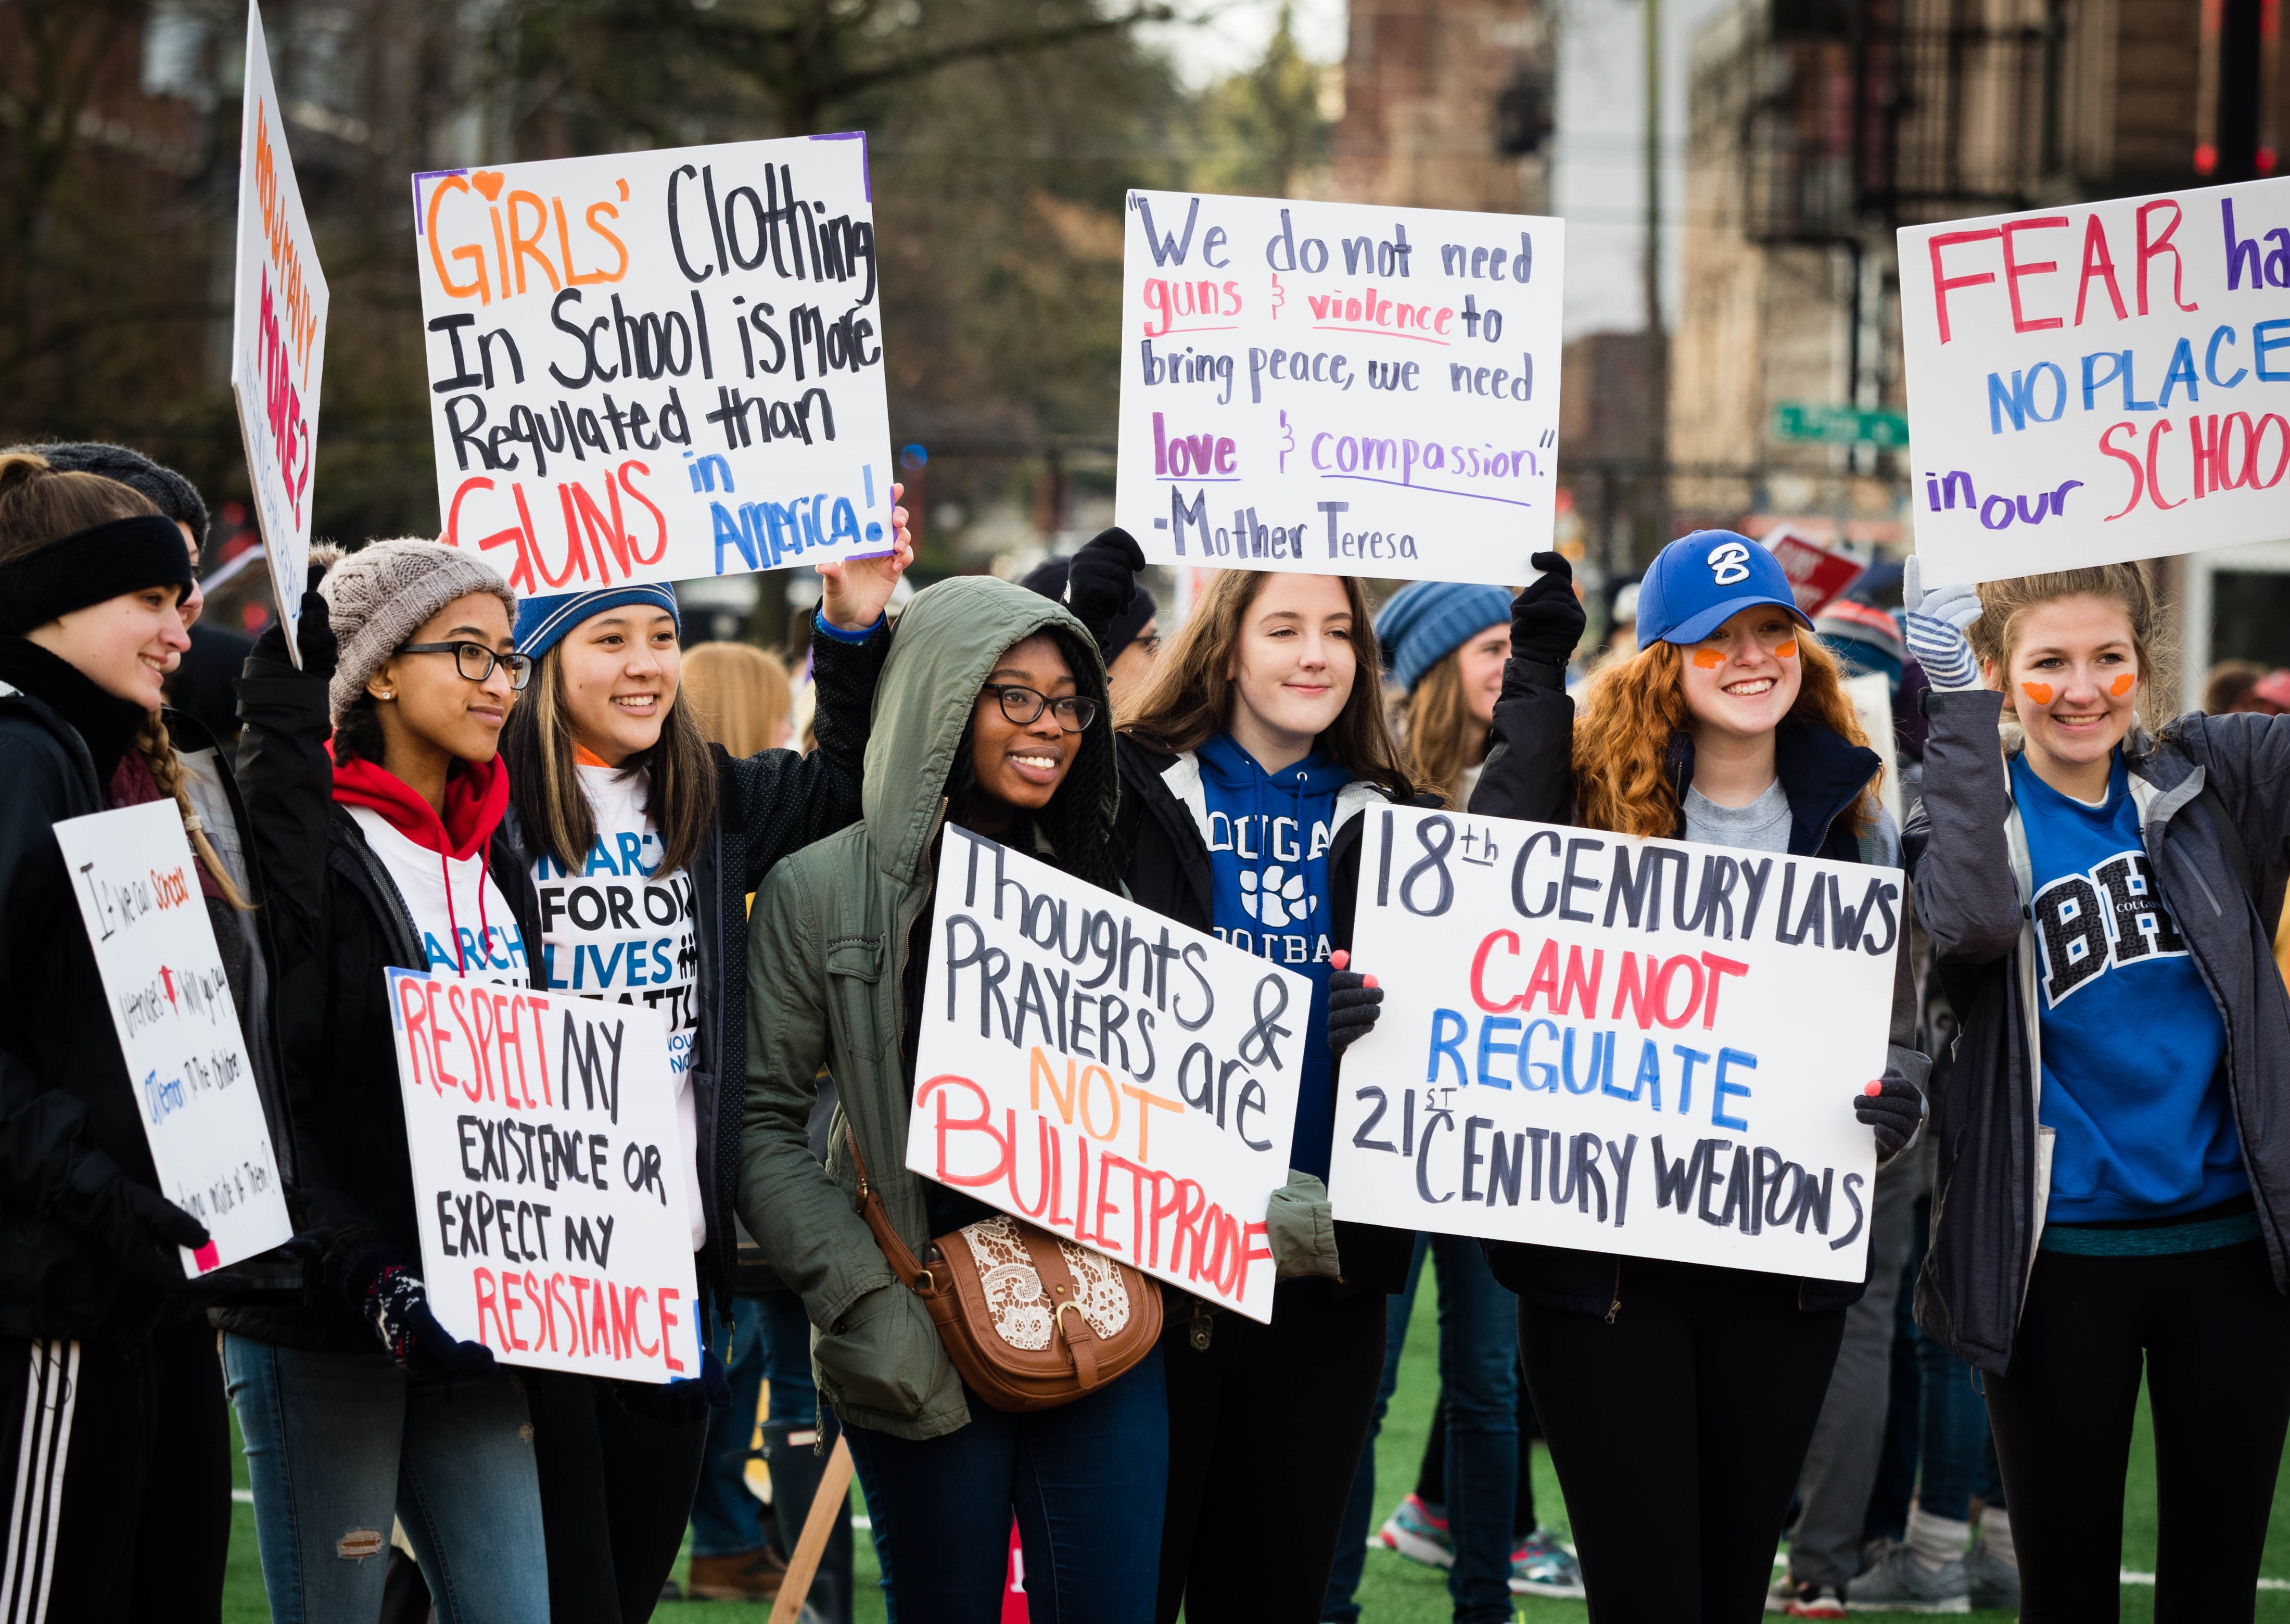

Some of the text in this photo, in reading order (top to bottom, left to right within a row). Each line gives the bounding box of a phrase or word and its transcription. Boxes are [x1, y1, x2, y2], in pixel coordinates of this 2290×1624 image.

[256, 95, 317, 392] HOW MANY
[668, 162, 876, 306] Clothing
[1266, 208, 1329, 274] do
[1341, 223, 1413, 277] not
[1441, 232, 1533, 284] need
[1928, 198, 2290, 346] FEAR ha
[428, 313, 525, 394] In
[548, 288, 714, 389] School
[731, 295, 786, 378] is
[1144, 277, 1242, 337] guns
[1308, 288, 1455, 335] violence
[1461, 294, 1503, 342] to
[258, 260, 309, 533] MORE?
[706, 386, 835, 450] than
[1141, 339, 1533, 405] bring peace, we need
[1987, 361, 2067, 435] NO
[2081, 319, 2290, 411] PLACE
[1152, 412, 1238, 477] love
[1926, 411, 2290, 530] in our SCHOO
[447, 459, 668, 595] GUNS
[682, 450, 735, 493] in
[1317, 501, 1418, 560] Teresa
[1707, 542, 1751, 586] B
[1207, 811, 1330, 862] OUGA
[424, 923, 529, 972] ARCH
[540, 885, 641, 933] FOR
[949, 822, 1292, 1071] Thoughts &
[1510, 830, 1773, 941] CENTURY
[1774, 861, 1899, 957] LAWS
[543, 938, 673, 989] LIVES
[400, 977, 624, 1125] RESPECT MY
[946, 914, 1274, 1152] PRAYERS are
[1426, 1007, 1758, 1133] REGULATE
[1030, 1045, 1184, 1164] NOT
[457, 1115, 667, 1208] EXISTENCE OR
[917, 1073, 1272, 1303] BULLETPROOF
[1416, 1112, 1639, 1229] CENTURY
[1651, 1133, 1865, 1252] WEAPONS
[437, 1190, 615, 1270] EXPECT MY
[474, 1266, 684, 1373] RESISTANCE
